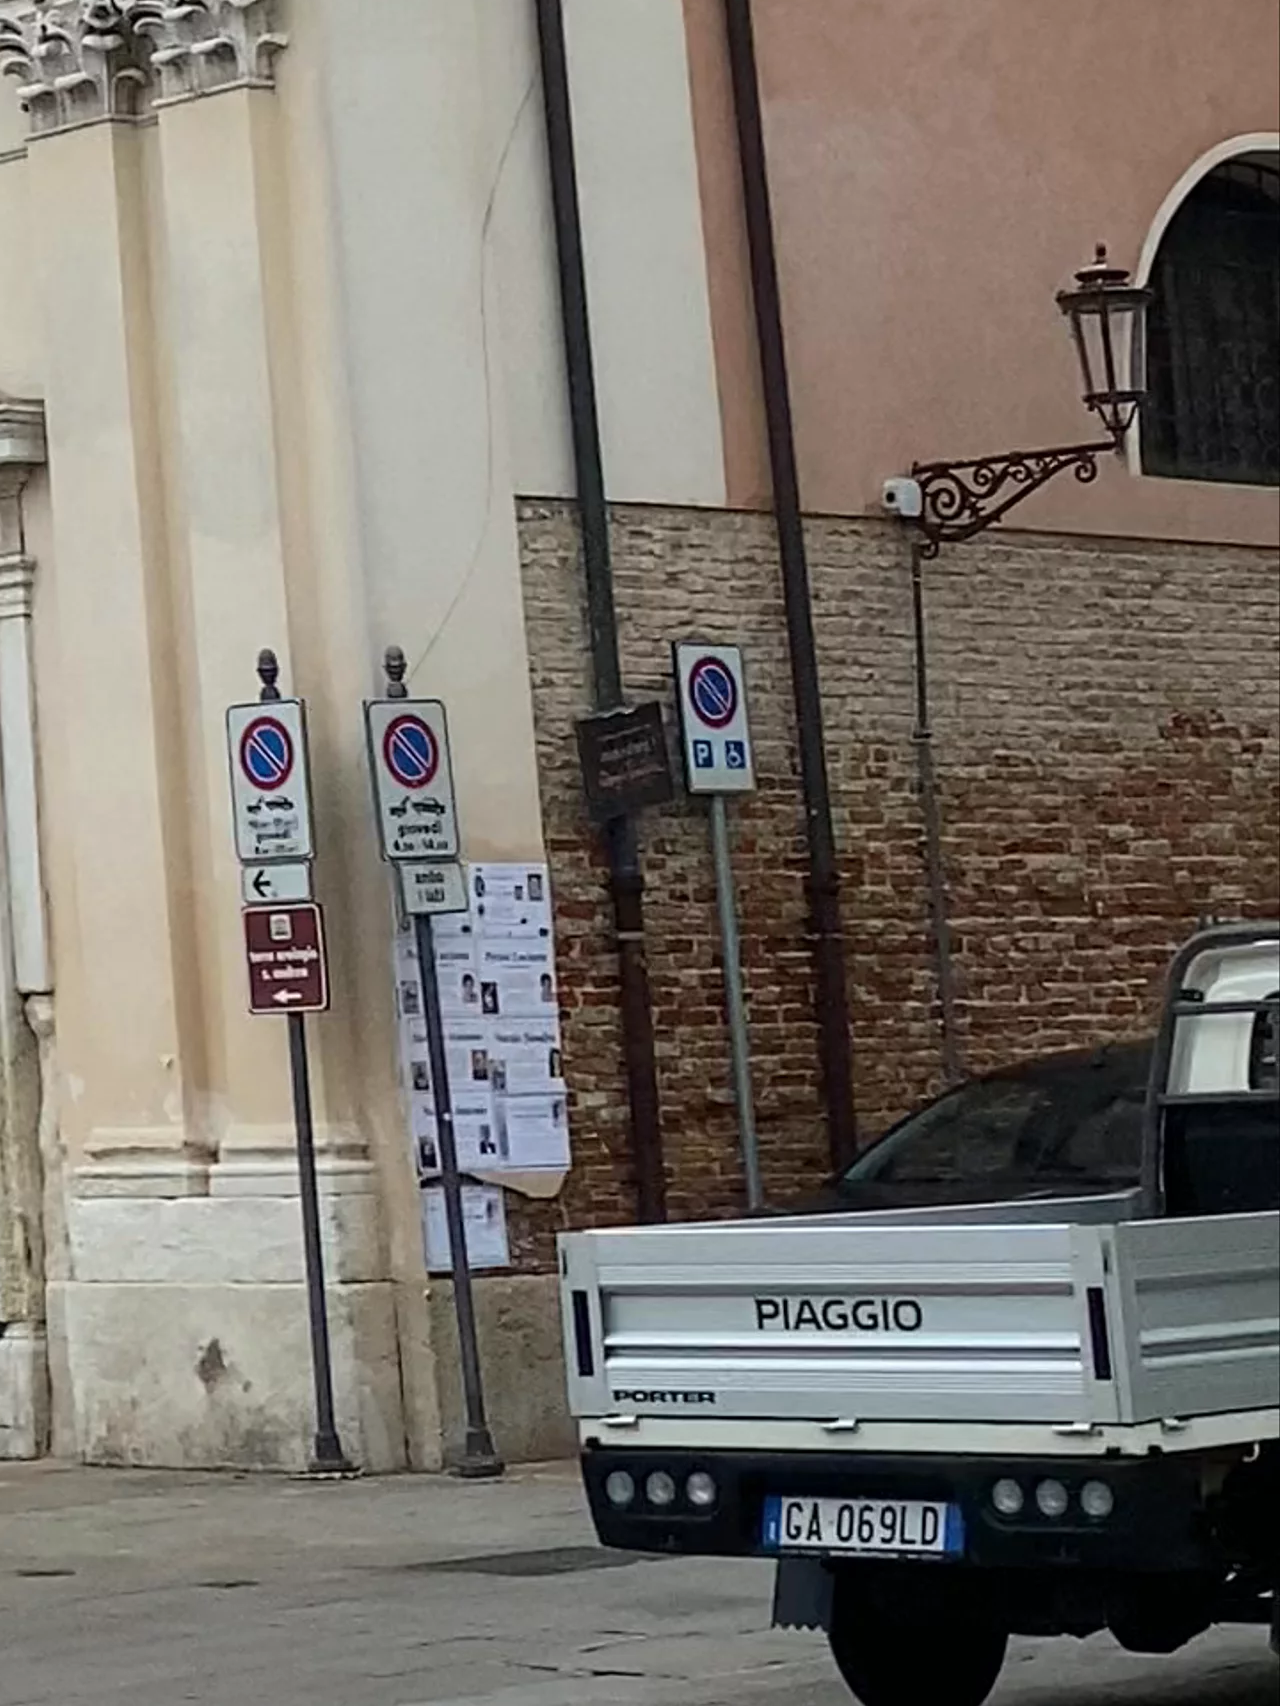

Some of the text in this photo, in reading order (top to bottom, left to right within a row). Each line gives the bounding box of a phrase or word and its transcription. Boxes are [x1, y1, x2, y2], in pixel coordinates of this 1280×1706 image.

[754, 1297, 924, 1333] PIAGGIO
[612, 1389, 717, 1405] PORTER
[784, 1501, 823, 1542] GA
[834, 1504, 940, 1547] 069LD
